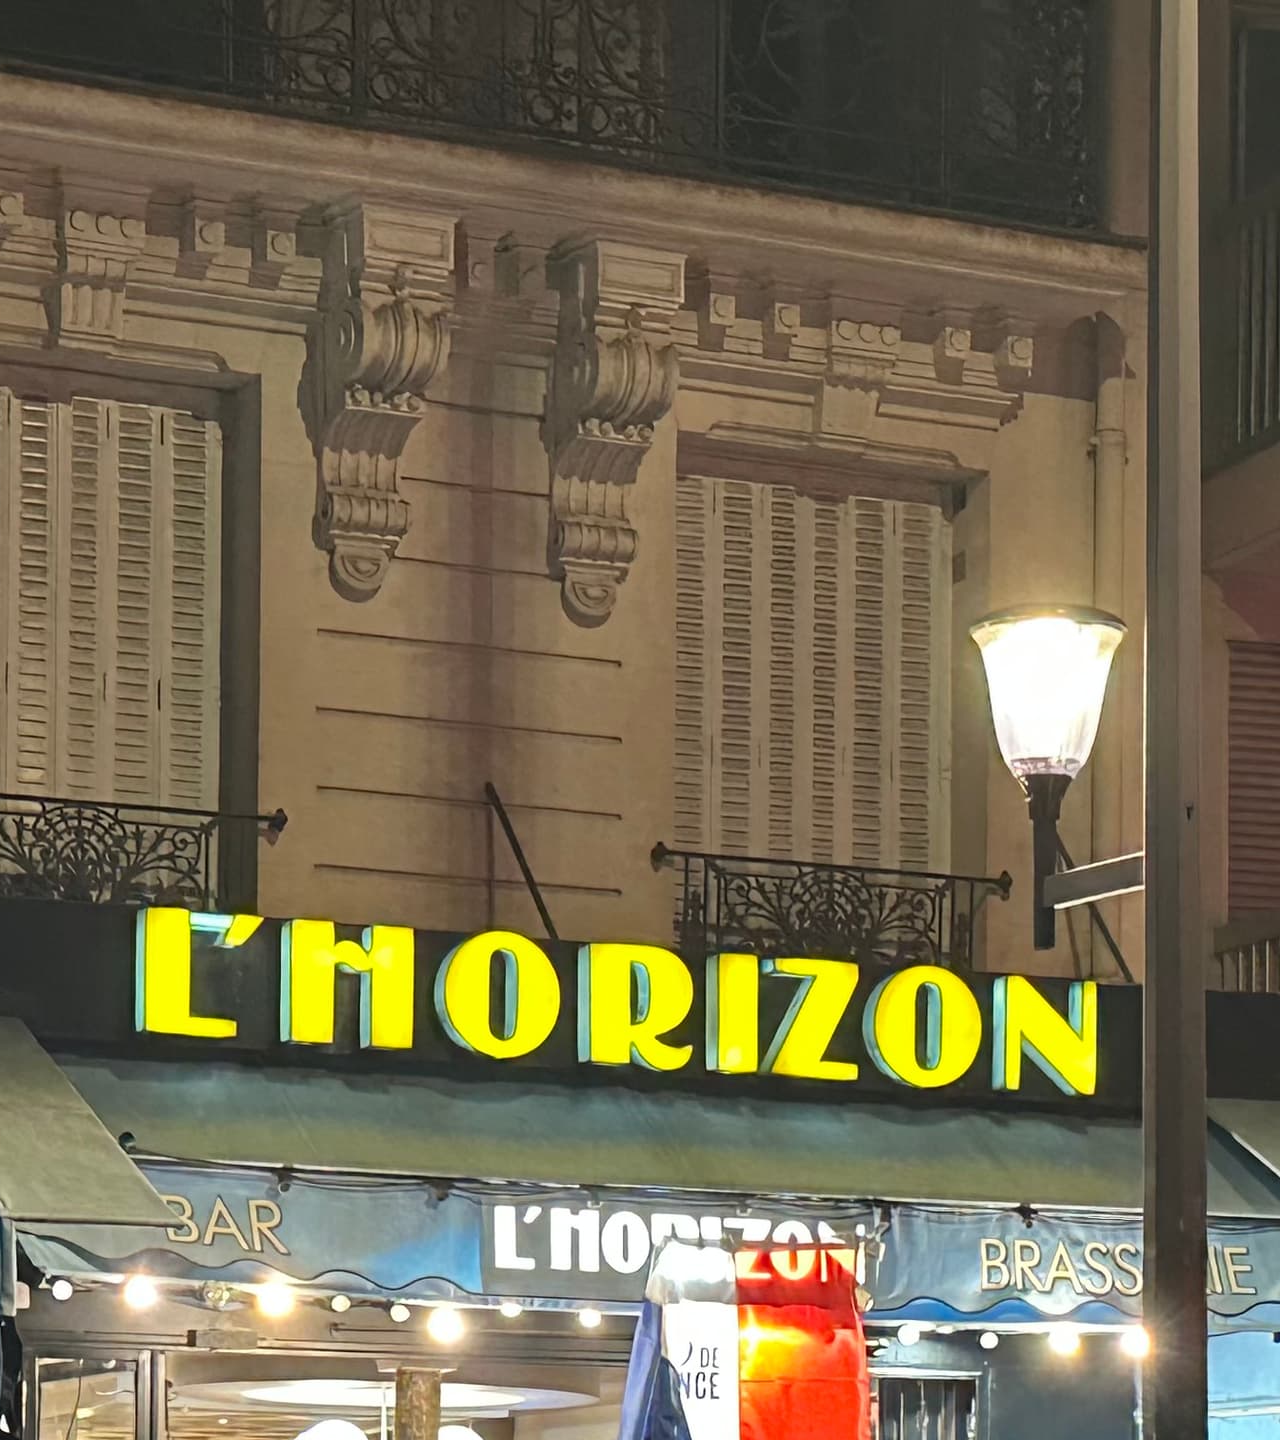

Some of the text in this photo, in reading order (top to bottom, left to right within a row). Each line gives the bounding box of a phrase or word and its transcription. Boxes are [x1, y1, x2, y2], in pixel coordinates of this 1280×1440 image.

[135, 907, 1098, 1095] L'HORIZON
[159, 1193, 291, 1255] BAR
[979, 1237, 1257, 1297] BRASSIE
[680, 1371, 720, 1400] NCE
